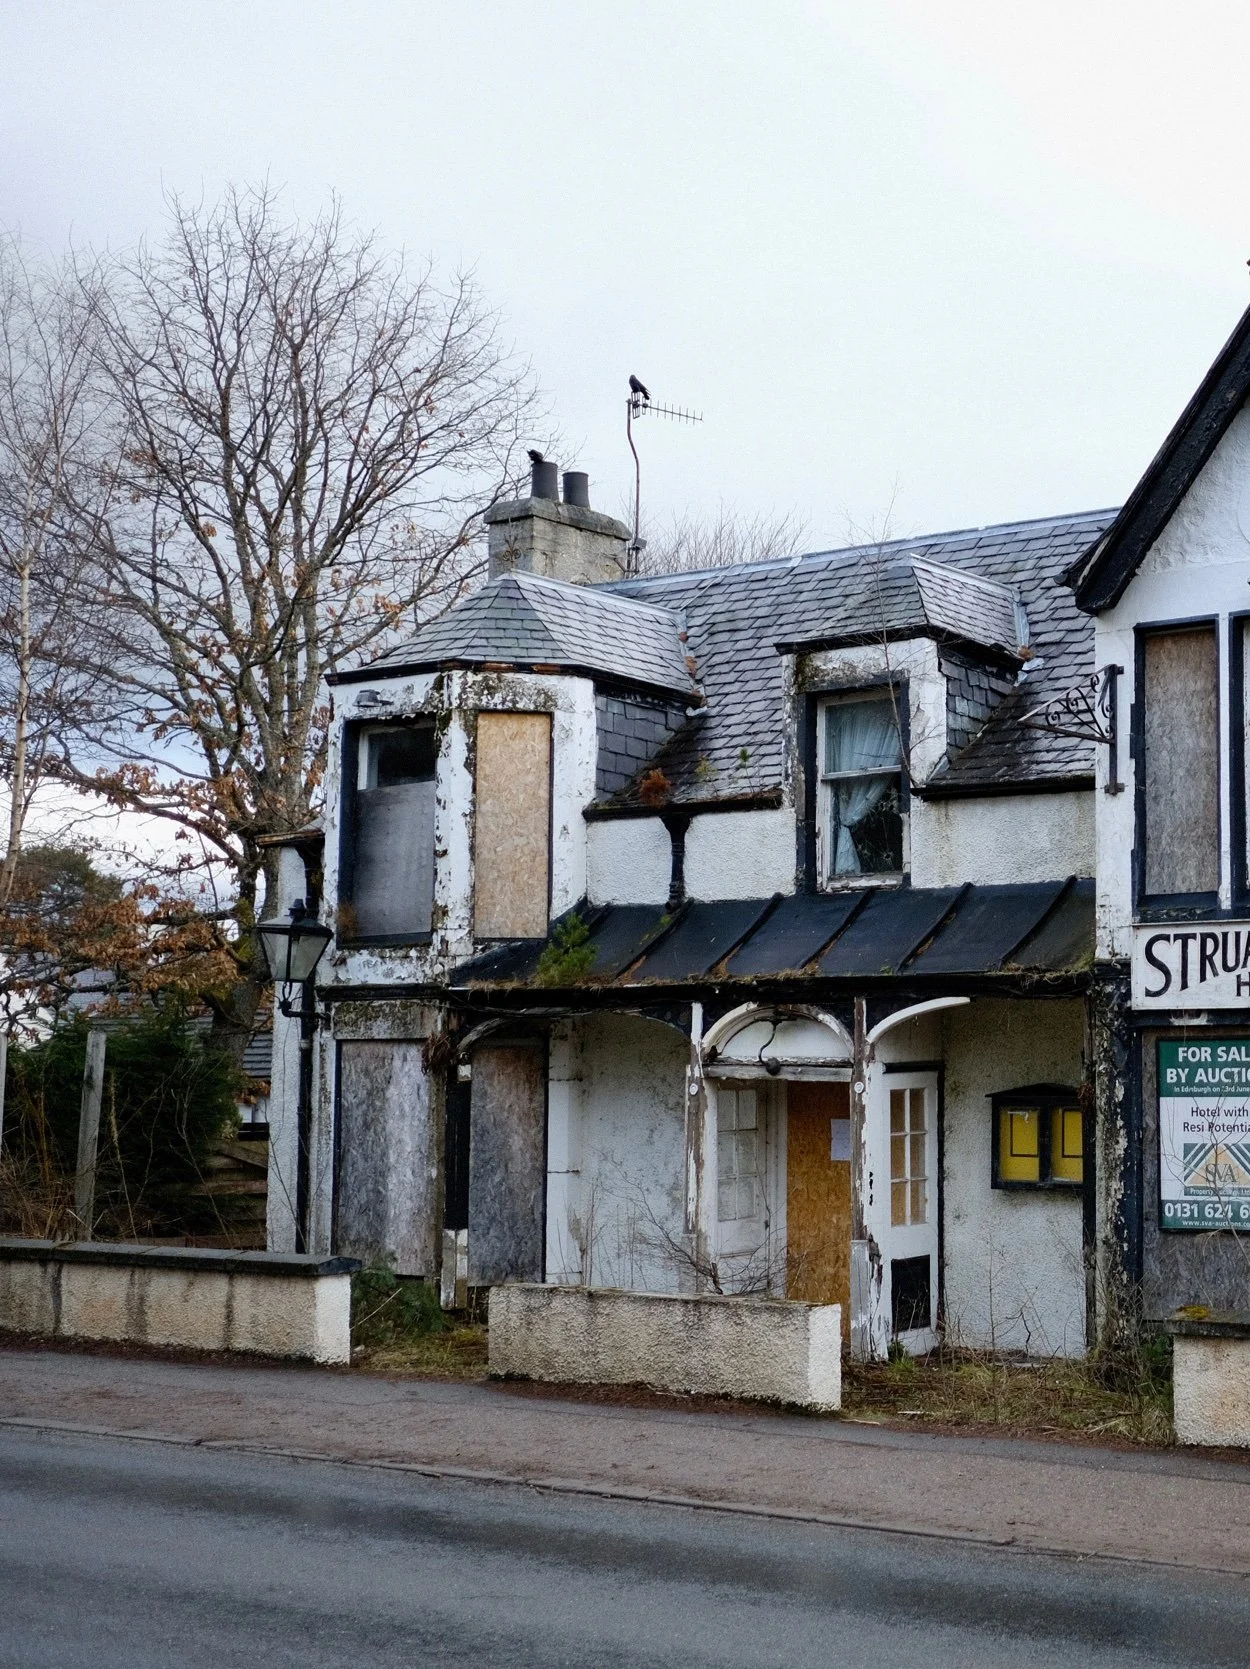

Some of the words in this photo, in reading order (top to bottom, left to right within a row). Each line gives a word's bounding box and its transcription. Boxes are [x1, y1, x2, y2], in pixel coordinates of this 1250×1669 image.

[1178, 1046, 1212, 1062] FOR
[1166, 1068, 1190, 1084] BY
[1181, 1086, 1212, 1094] Edinburgh
[1191, 1106, 1221, 1118] Hotel
[1224, 1106, 1249, 1117] with
[1183, 1121, 1204, 1133] Resi
[1205, 1163, 1238, 1182] SVA
[1164, 1202, 1199, 1218] 0131
[1204, 1203, 1233, 1218] 624
